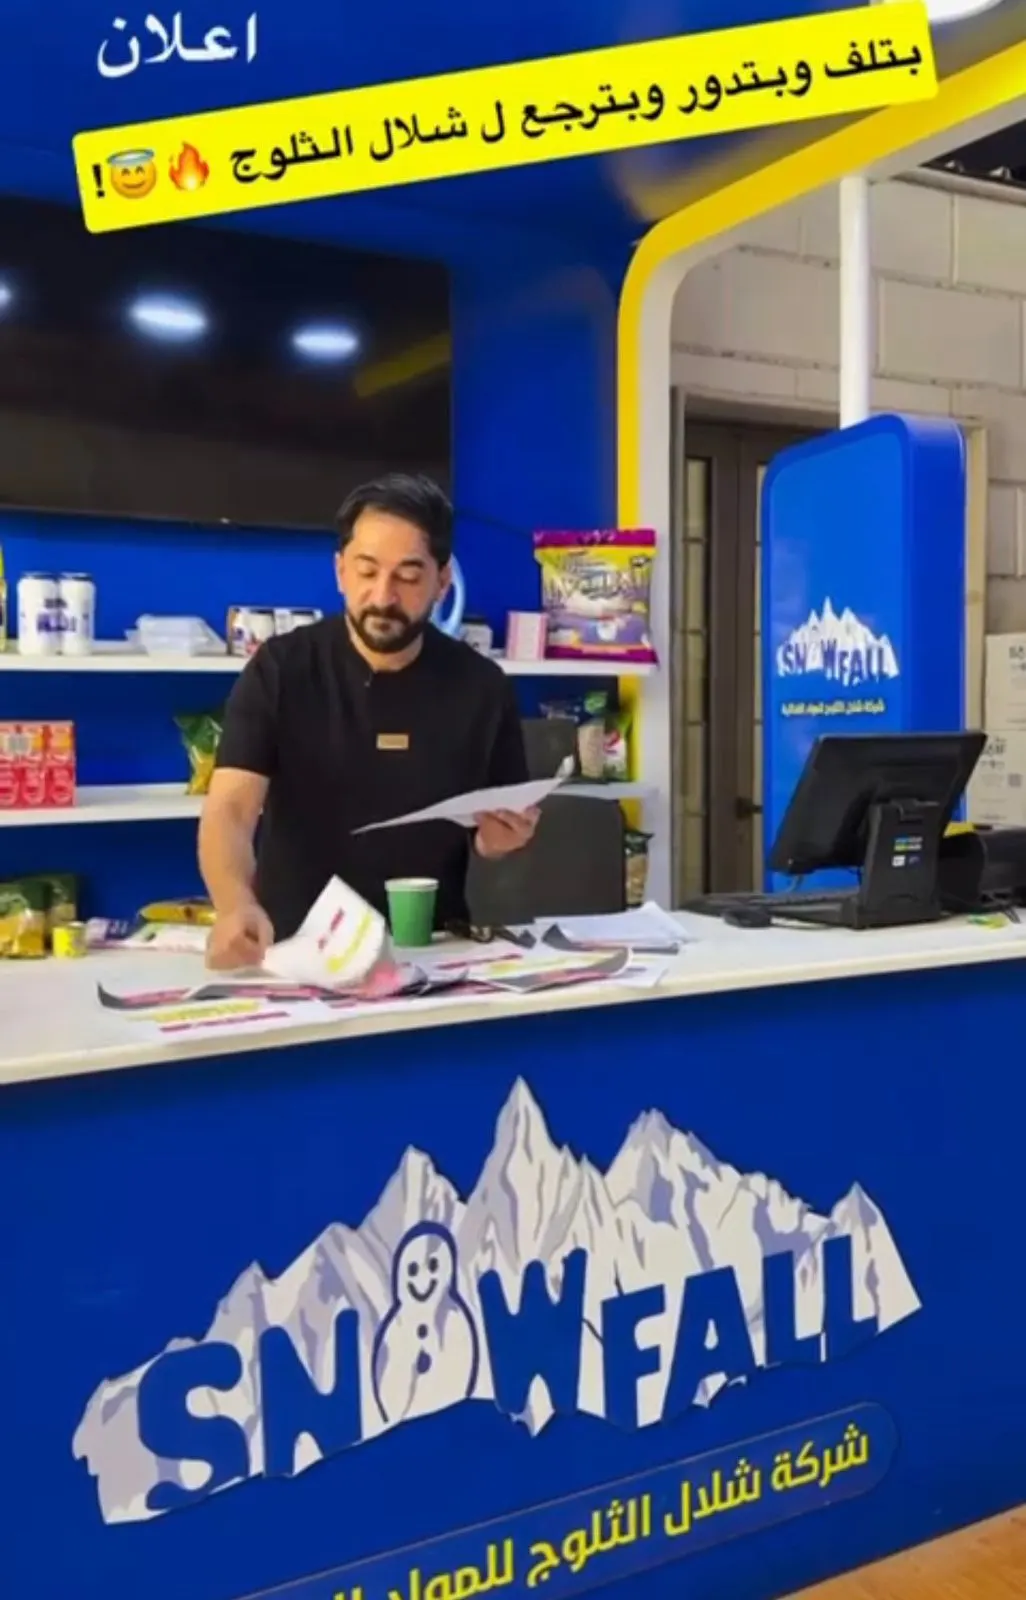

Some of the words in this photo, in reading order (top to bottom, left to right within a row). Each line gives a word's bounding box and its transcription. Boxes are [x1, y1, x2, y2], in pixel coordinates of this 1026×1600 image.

[138, 1221, 878, 1510] SNOWFALL
[664, 1458, 761, 1536] شلال
[771, 1423, 868, 1490] شركة
[526, 1494, 650, 1588] الثلوج
